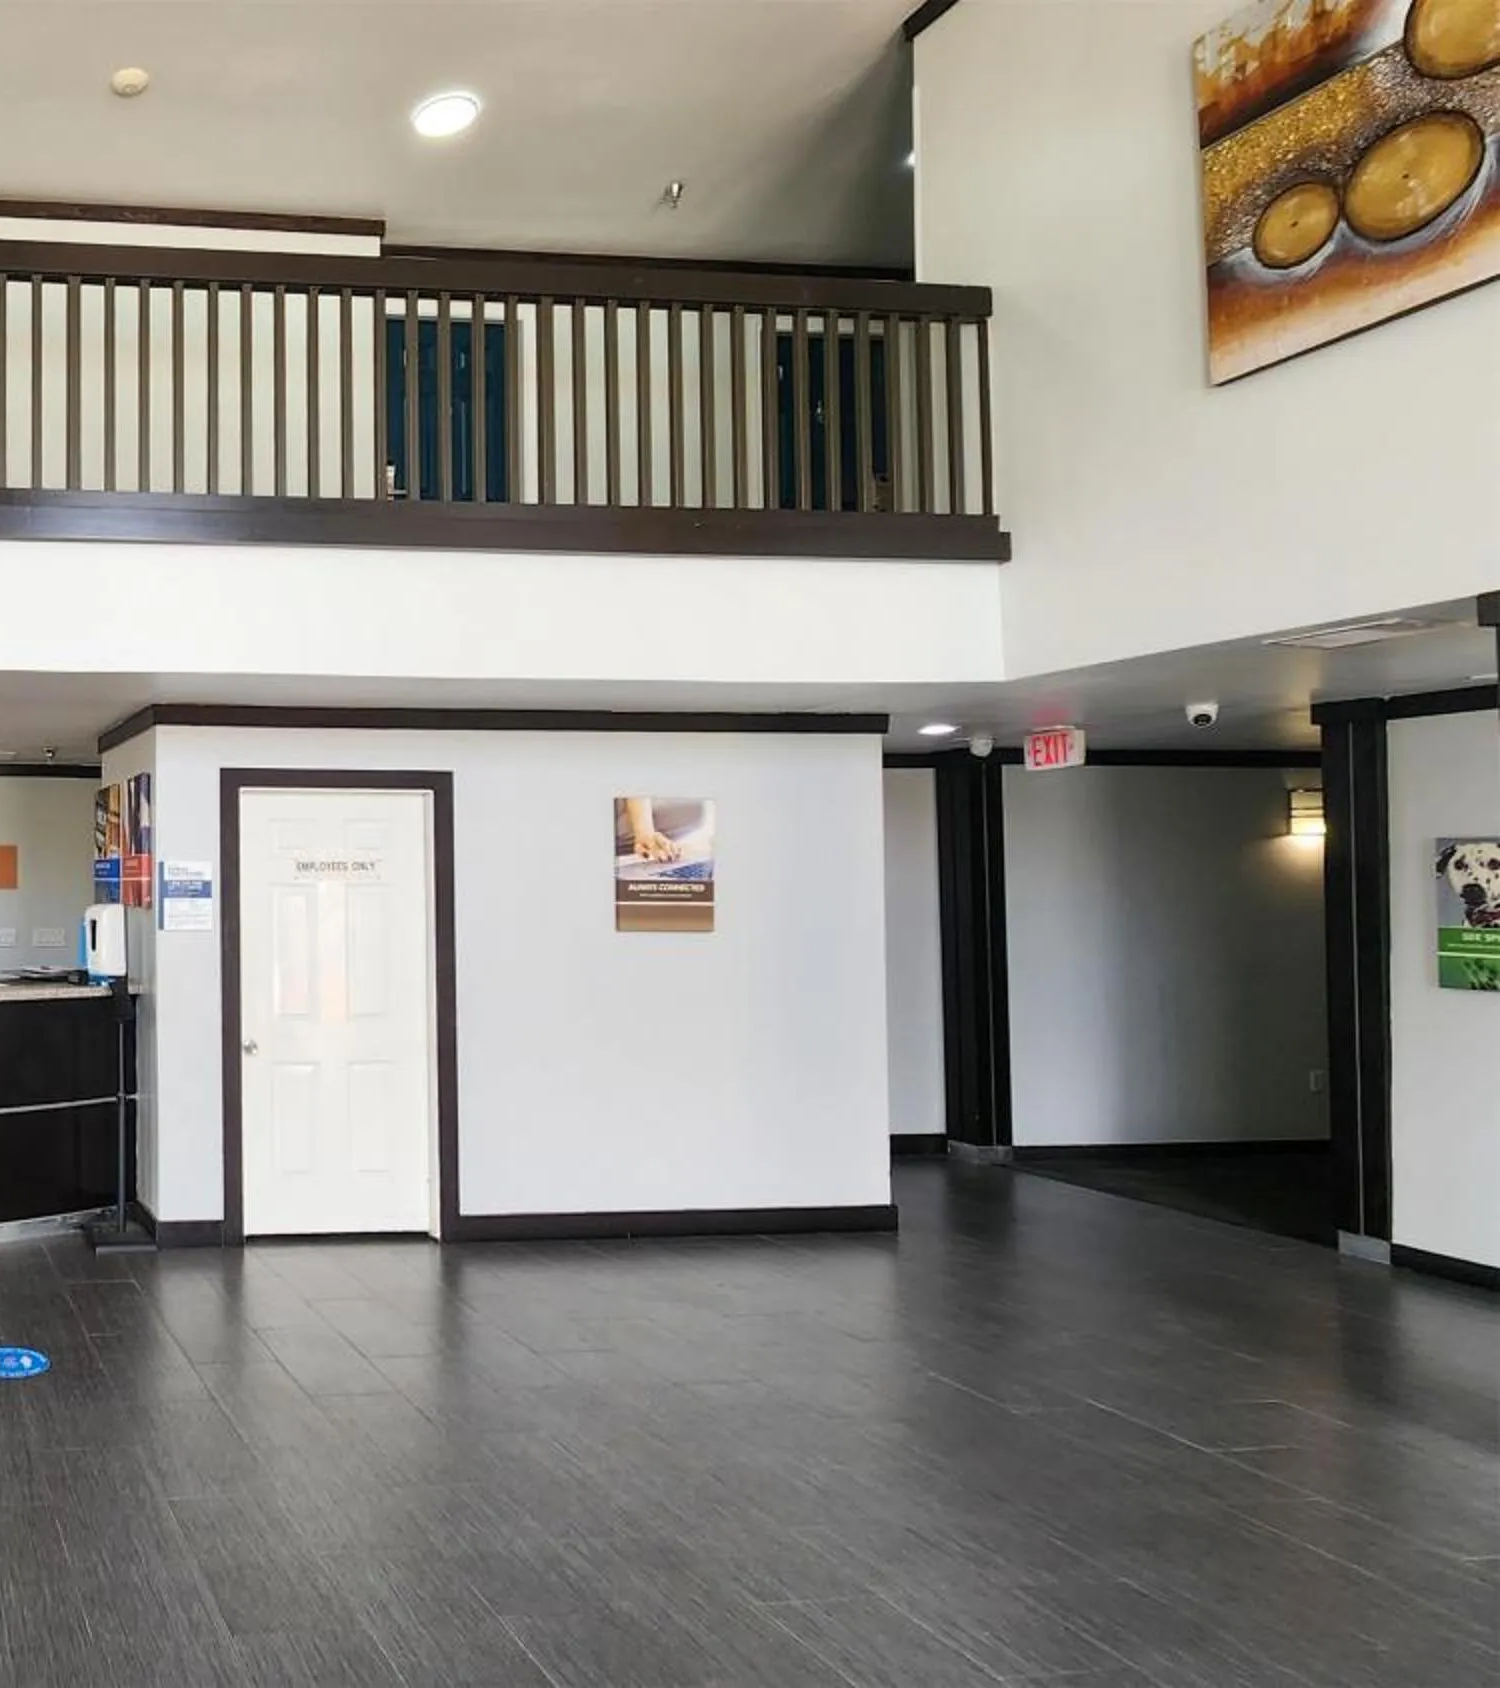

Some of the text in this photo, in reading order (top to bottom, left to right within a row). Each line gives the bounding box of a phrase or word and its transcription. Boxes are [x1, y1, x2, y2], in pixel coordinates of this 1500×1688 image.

[1031, 732, 1068, 768] EXIT
[296, 861, 375, 872] EMPLOYEES ONLY
